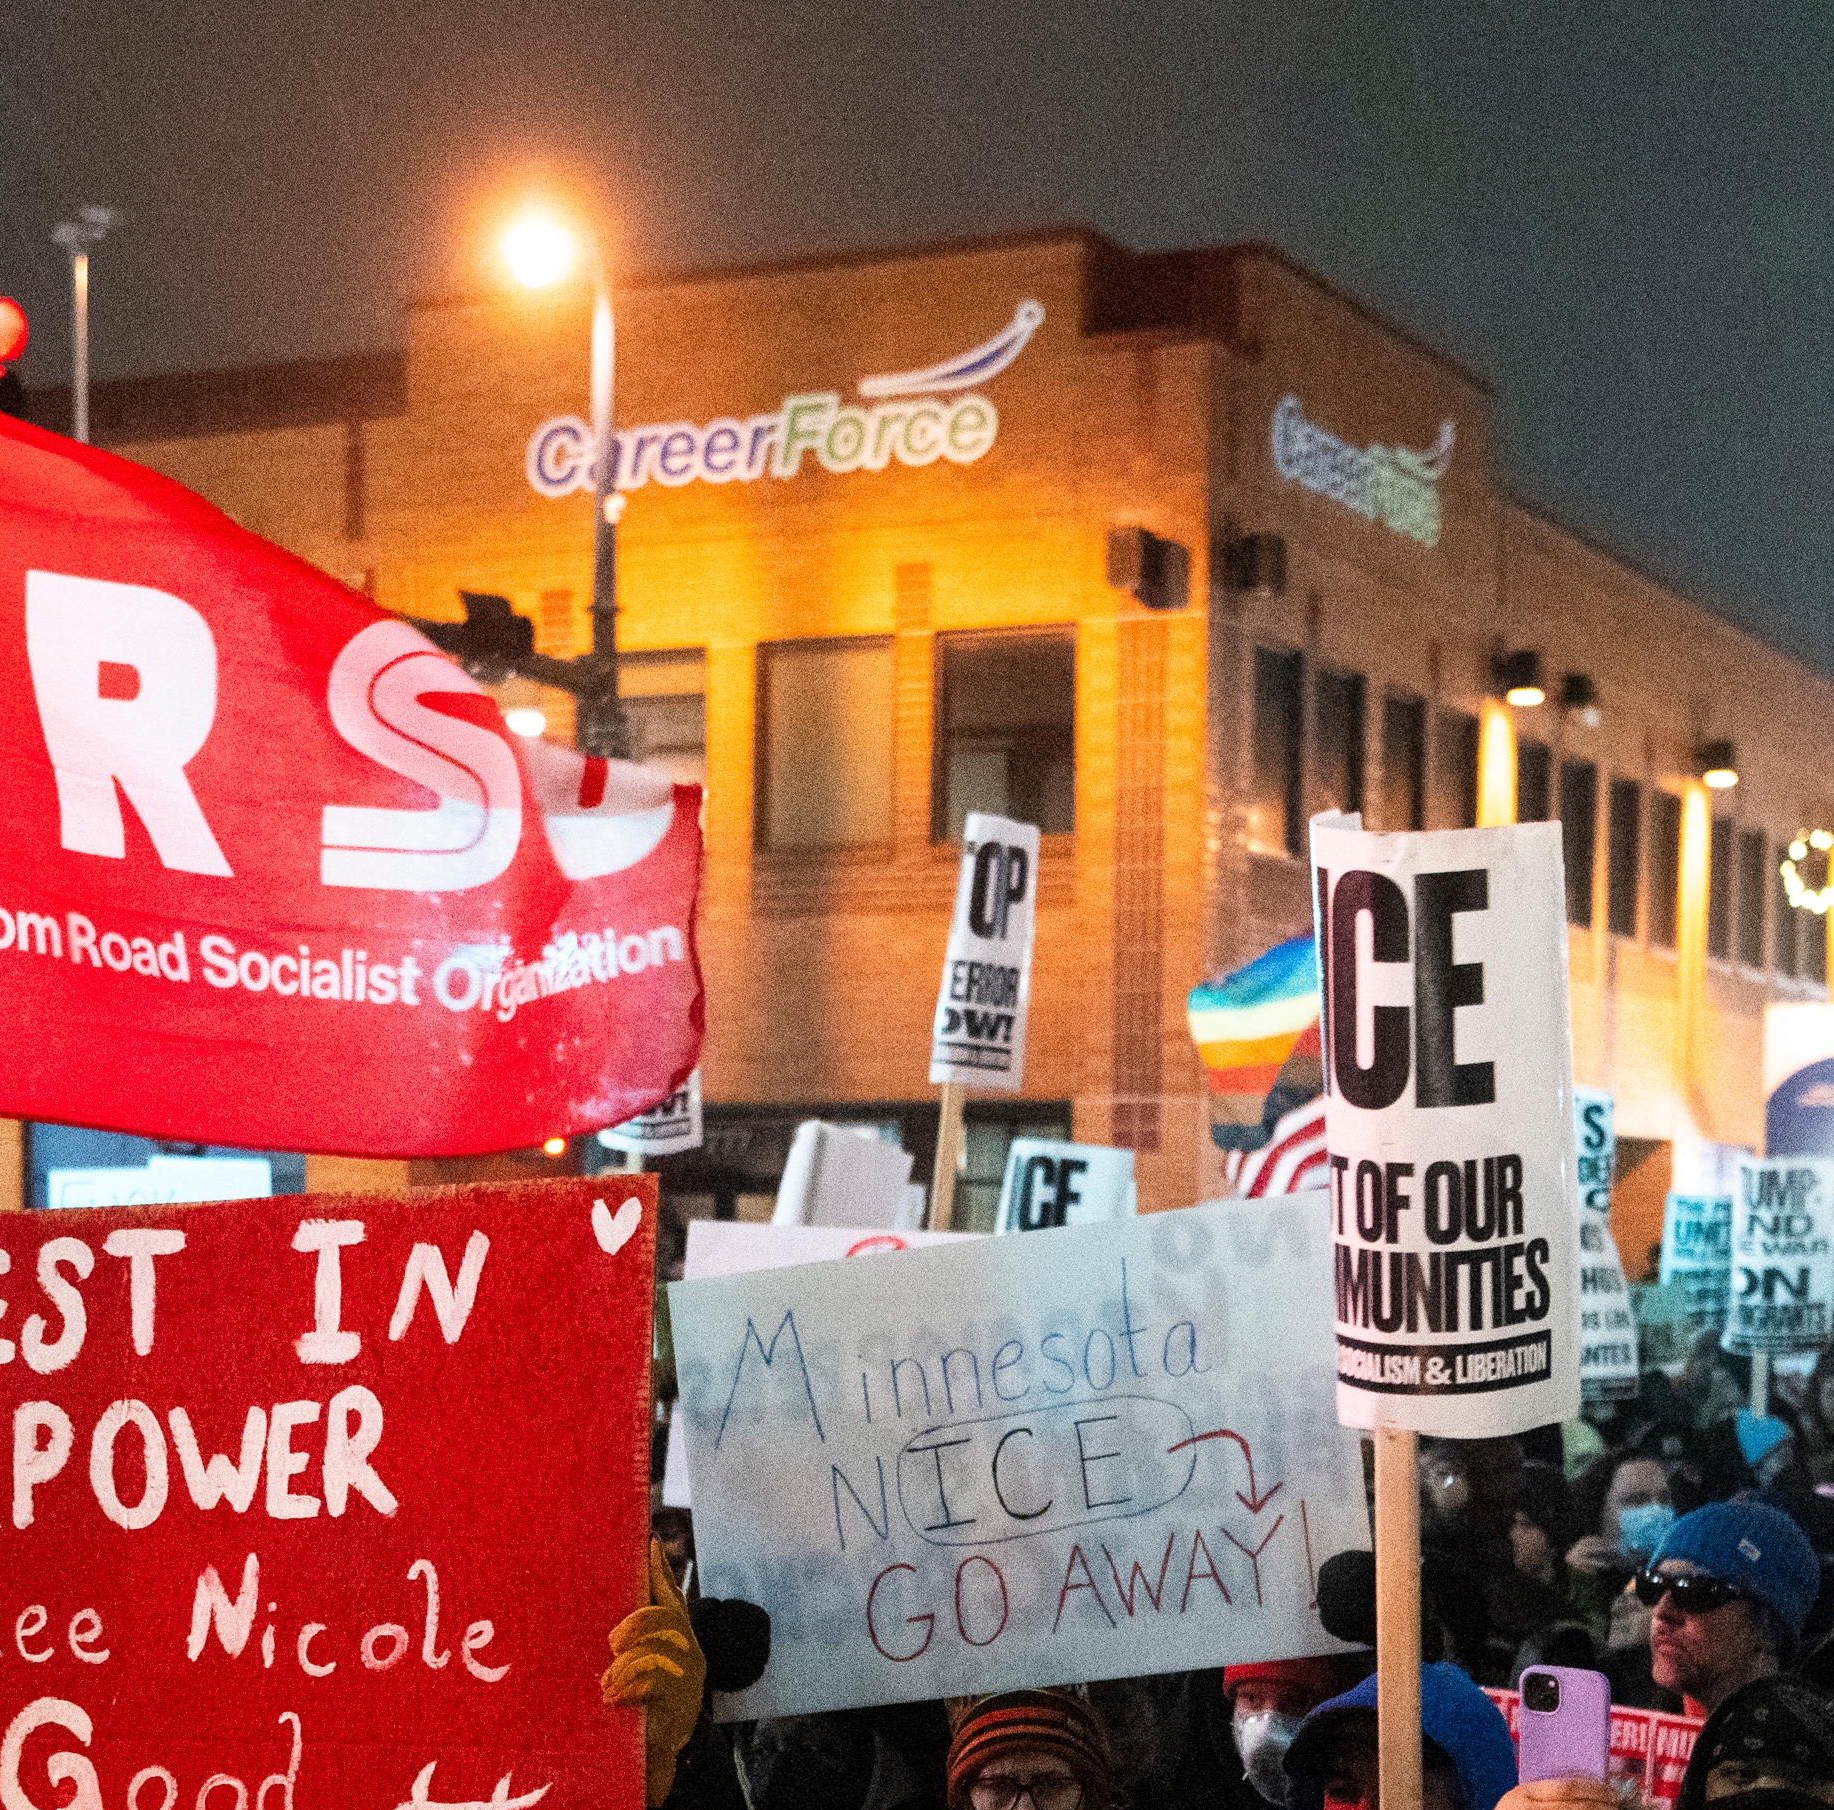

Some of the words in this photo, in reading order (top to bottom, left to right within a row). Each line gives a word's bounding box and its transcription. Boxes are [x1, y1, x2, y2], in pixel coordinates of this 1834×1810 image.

[967, 841, 1029, 940] OP
[66, 911, 191, 984] Road
[200, 933, 422, 1008] Socialist
[1356, 1159, 1415, 1245] OF
[1424, 1153, 1524, 1246] OUR
[291, 1218, 492, 1367] IN
[1333, 1237, 1551, 1335] MUNITIES
[714, 1256, 1216, 1452] Minnesota
[1425, 1355, 1453, 1386] &
[1456, 1341, 1547, 1385] LIBERATION
[12, 1384, 399, 1532] POWER
[831, 1414, 1137, 1552] NICE
[187, 1552, 512, 1684] Nicole
[867, 1554, 1009, 1662] GO
